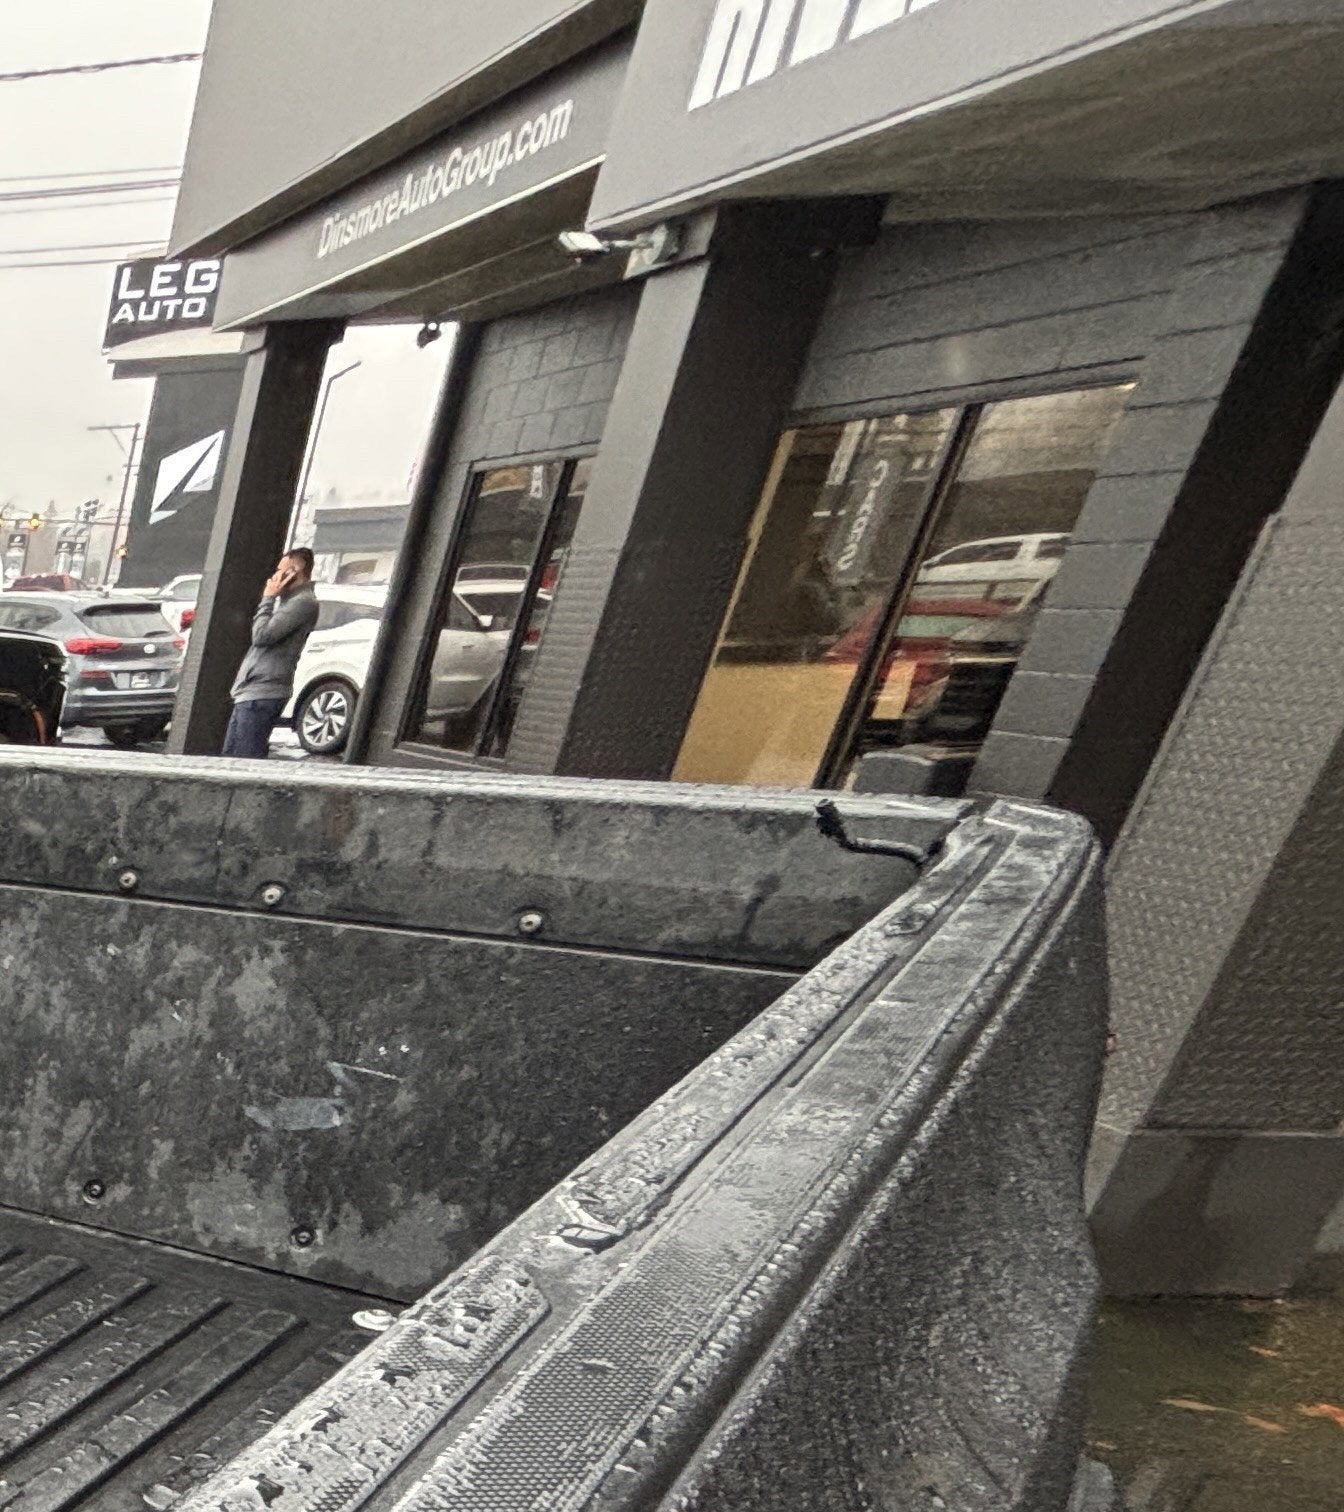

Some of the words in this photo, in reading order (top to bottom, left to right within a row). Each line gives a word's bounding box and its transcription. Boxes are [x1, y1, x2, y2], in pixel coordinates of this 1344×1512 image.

[317, 99, 573, 259] DinsmoreAutoGroup.com
[118, 260, 220, 300] LEG
[112, 297, 206, 324] AUTO
